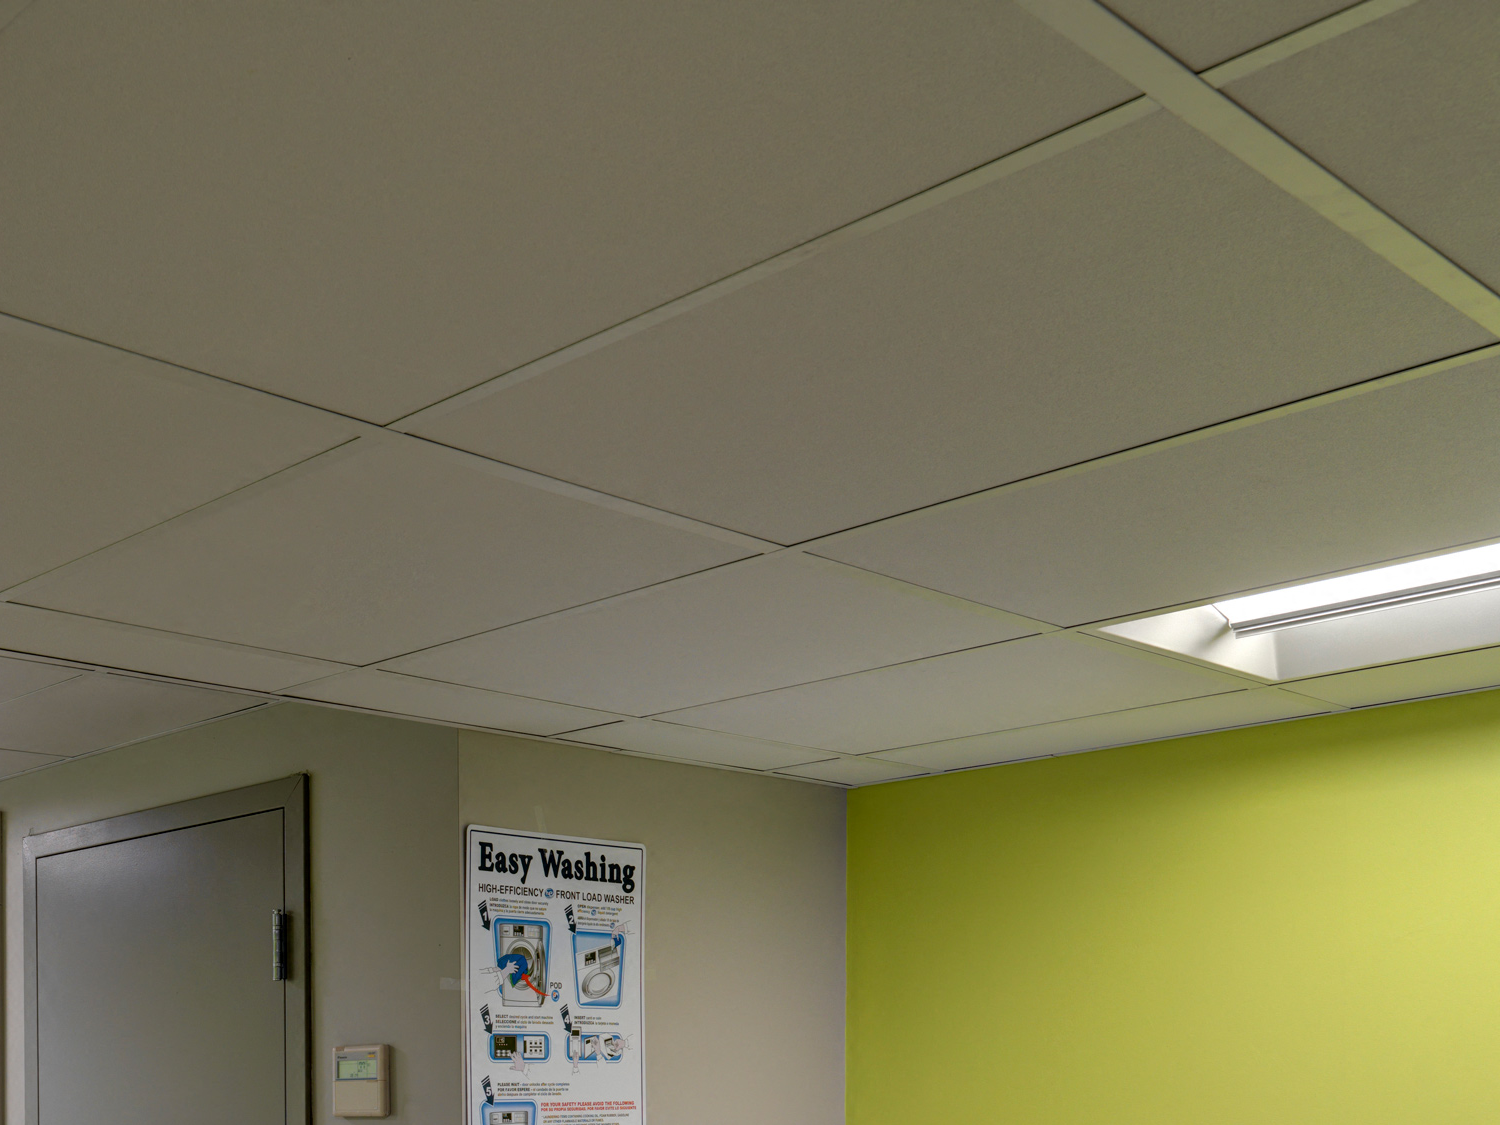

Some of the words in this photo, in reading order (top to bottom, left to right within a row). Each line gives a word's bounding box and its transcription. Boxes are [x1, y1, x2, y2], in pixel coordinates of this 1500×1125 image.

[478, 842, 533, 884] Easy
[538, 848, 635, 893] Washing
[479, 883, 543, 897] HIGH-EFFICIENCY
[556, 890, 580, 900] FRONT
[583, 893, 601, 901] LOAD
[604, 895, 634, 904] WASHER
[483, 912, 488, 921] 1
[568, 915, 574, 924] 2
[484, 1015, 490, 1025] 3
[486, 1087, 492, 1096] 5
